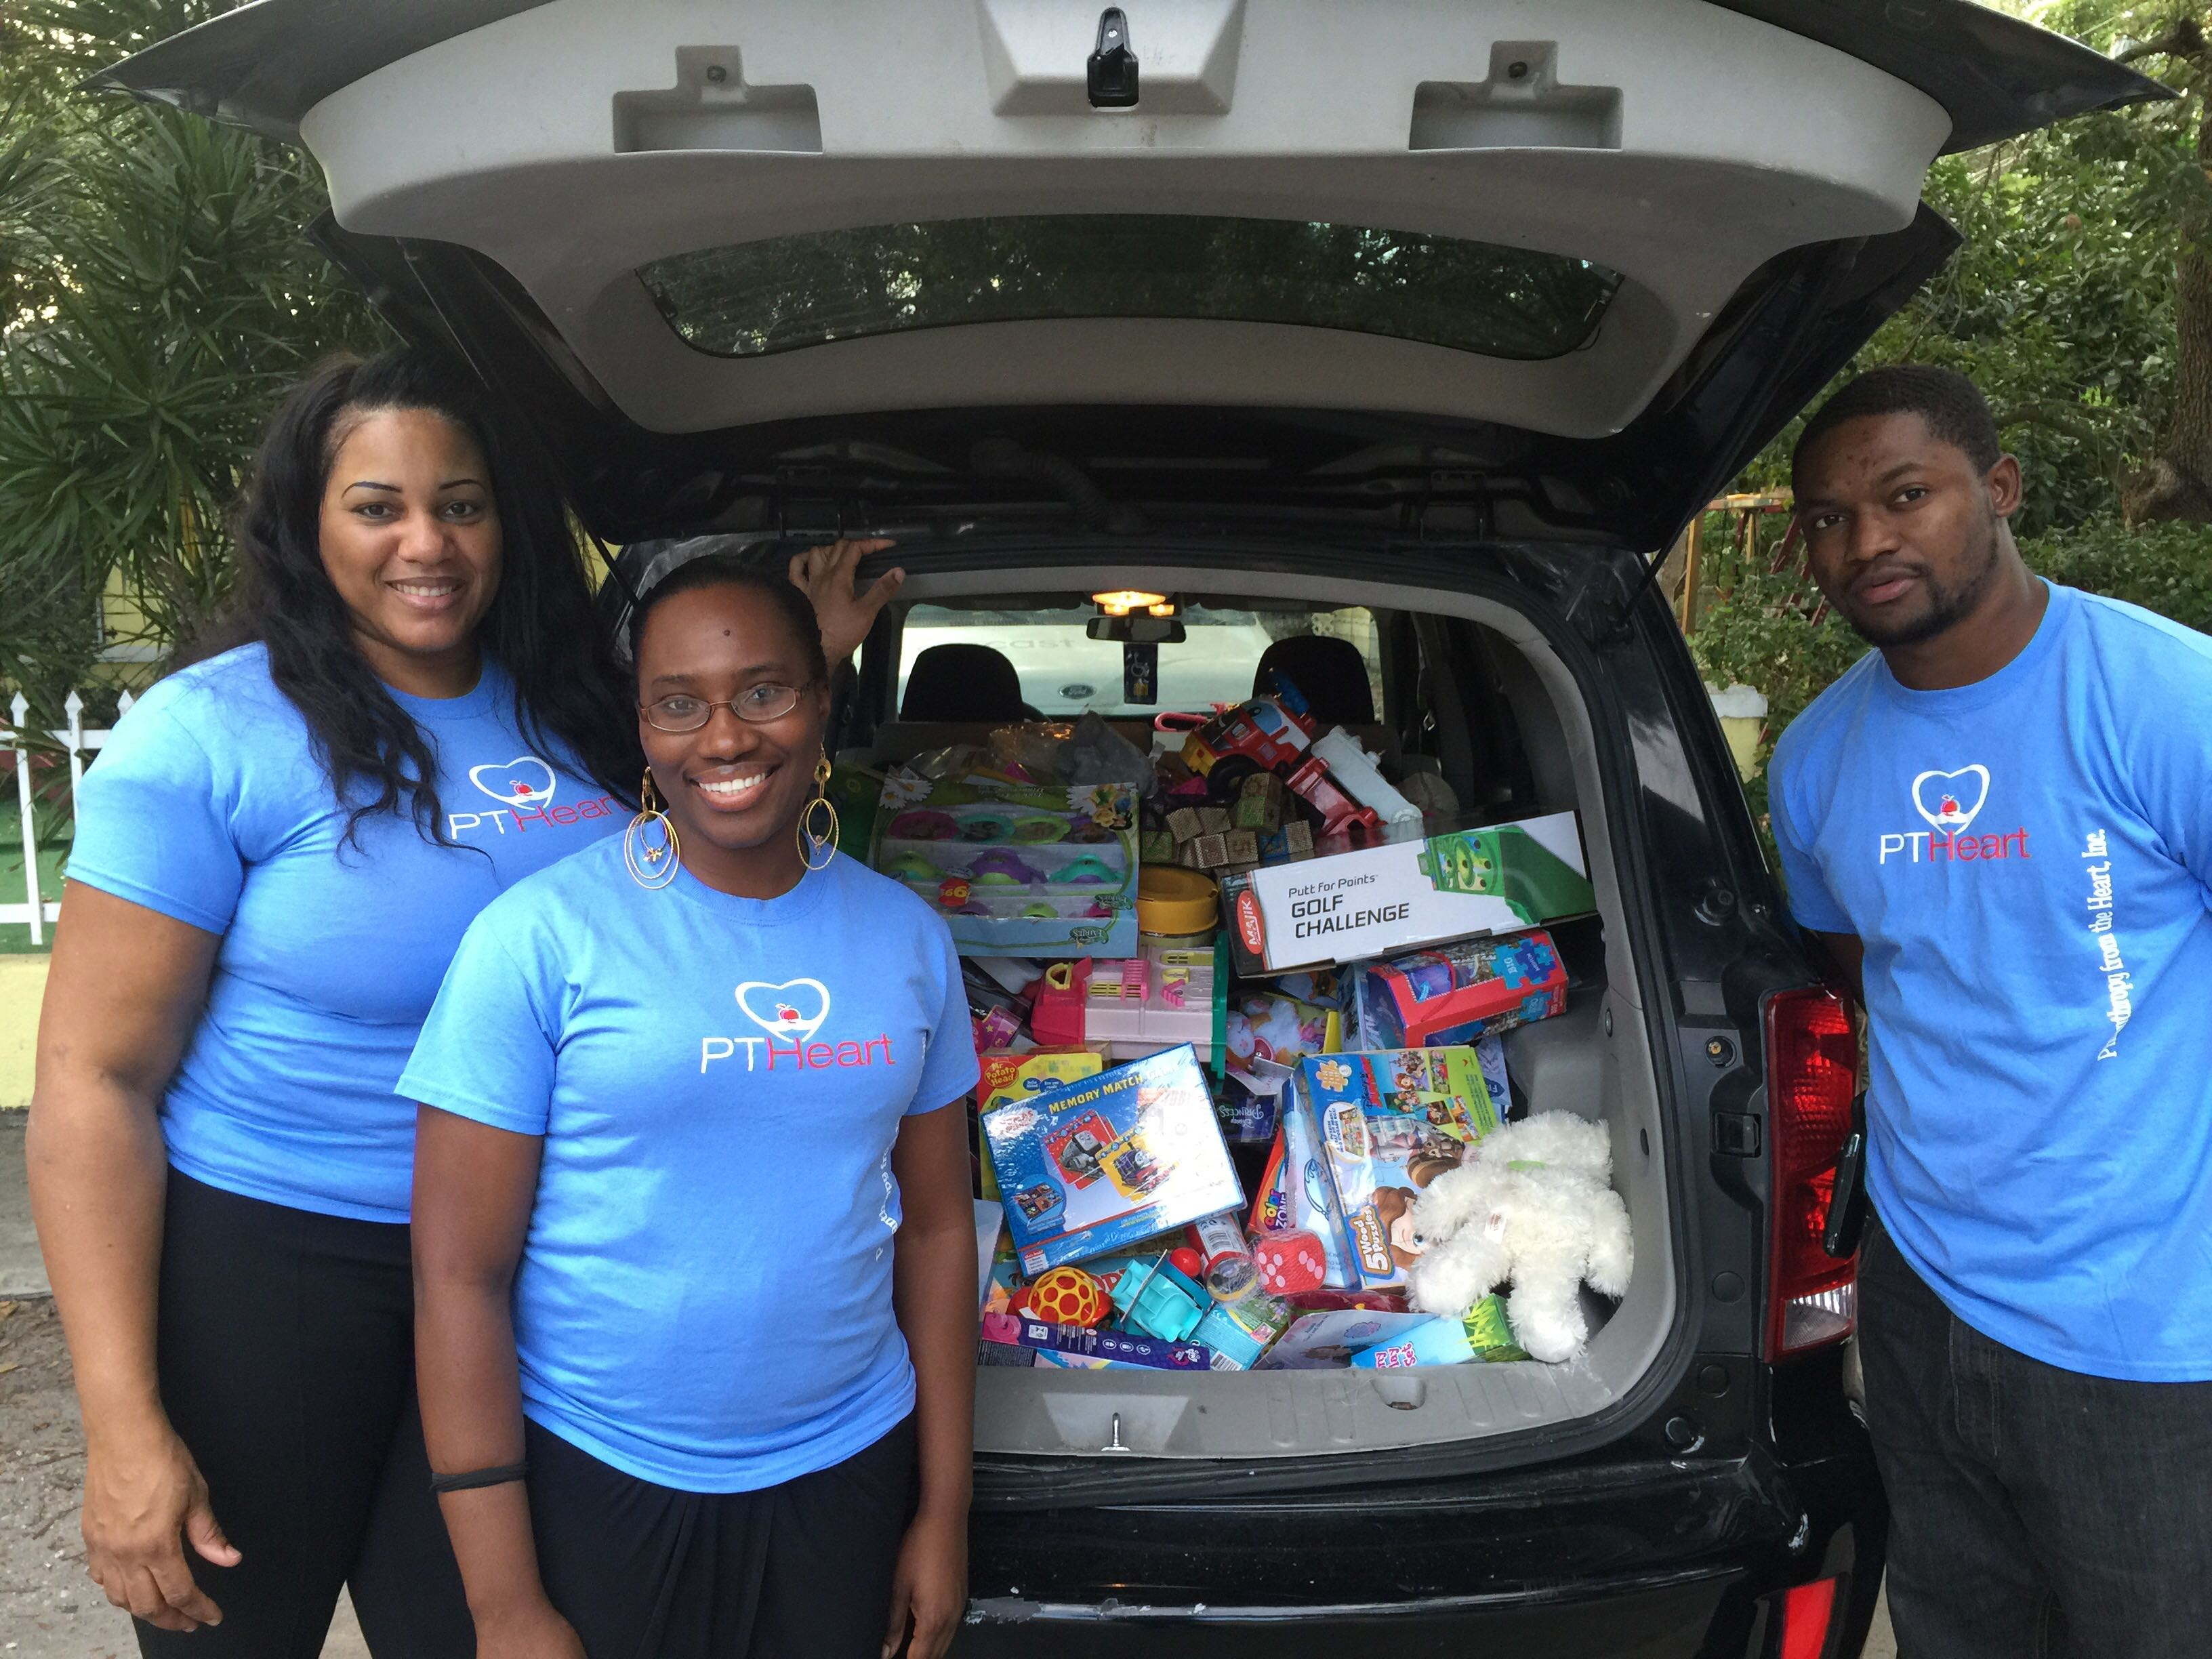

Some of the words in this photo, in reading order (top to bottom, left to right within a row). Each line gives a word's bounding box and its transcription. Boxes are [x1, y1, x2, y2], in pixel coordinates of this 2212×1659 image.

[1880, 826, 2032, 864] PTHeart
[2082, 828, 2107, 858] Inc.
[1288, 885, 1315, 898] Putt
[1317, 880, 1336, 893] for
[2087, 861, 2113, 910] Heart,
[1292, 895, 1343, 918] GOLF
[1295, 903, 1410, 939] CHALLENGE
[1246, 899, 1263, 945] MAJIK
[2089, 911, 2113, 933] the
[1504, 957, 1517, 975] BIG
[2100, 933, 2124, 972] from
[2097, 972, 2133, 1061] Pnthropy
[701, 1033, 895, 1073] PTHeart
[986, 1066, 1016, 1080] Potato
[990, 1073, 1014, 1086] Head
[1048, 1088, 1100, 1114] MEMORY
[1103, 1076, 1143, 1096] MATCH
[1219, 1104, 1264, 1120] PRINCESS
[1353, 1220, 1372, 1254] Wood
[1365, 1252, 1388, 1271] 5
[1401, 1343, 1416, 1366] Set
